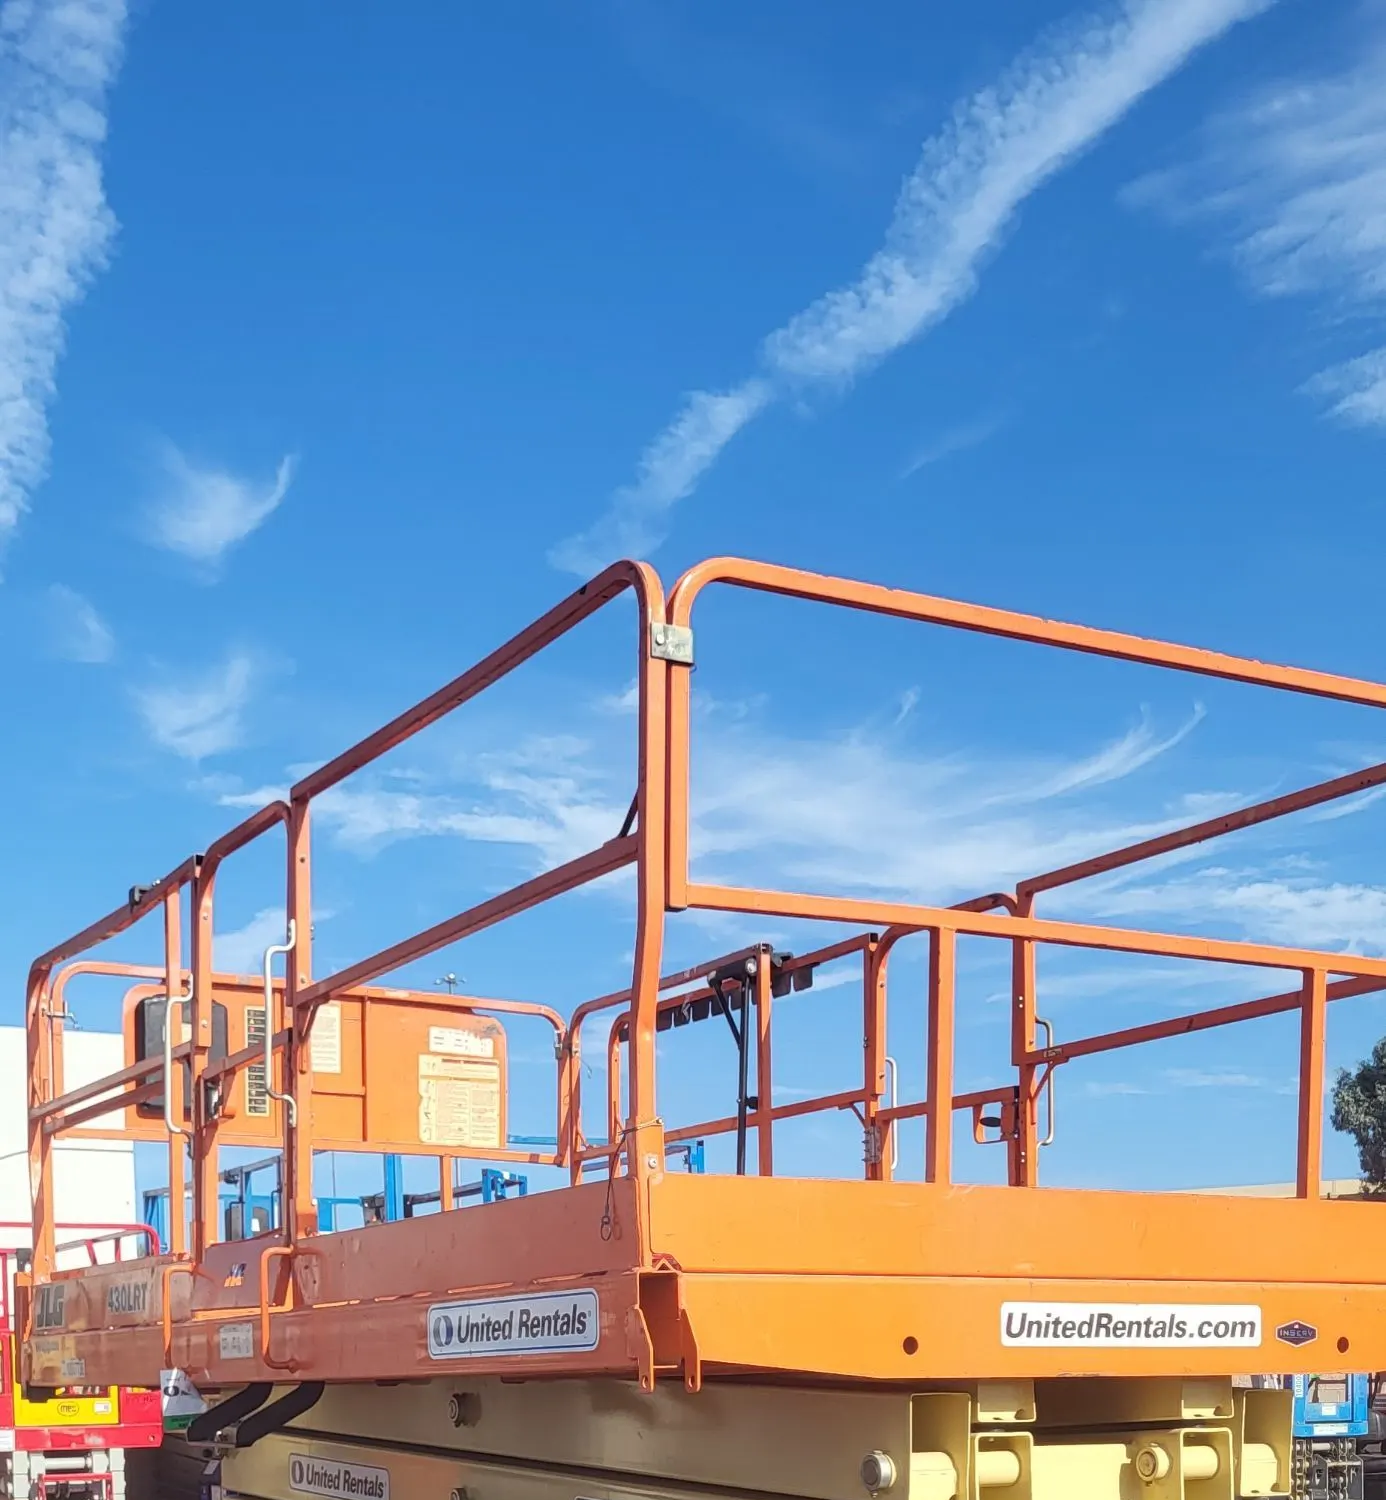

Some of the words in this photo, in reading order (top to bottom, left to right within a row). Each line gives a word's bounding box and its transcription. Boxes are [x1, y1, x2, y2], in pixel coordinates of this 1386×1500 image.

[37, 1285, 65, 1328] JLG
[108, 1281, 148, 1312] 430LRT
[457, 1310, 514, 1344] United
[518, 1304, 587, 1339] Rentals
[1005, 1313, 1256, 1339] UnitedRentals.com
[306, 1463, 340, 1490] United
[343, 1470, 384, 1498] Rentals
